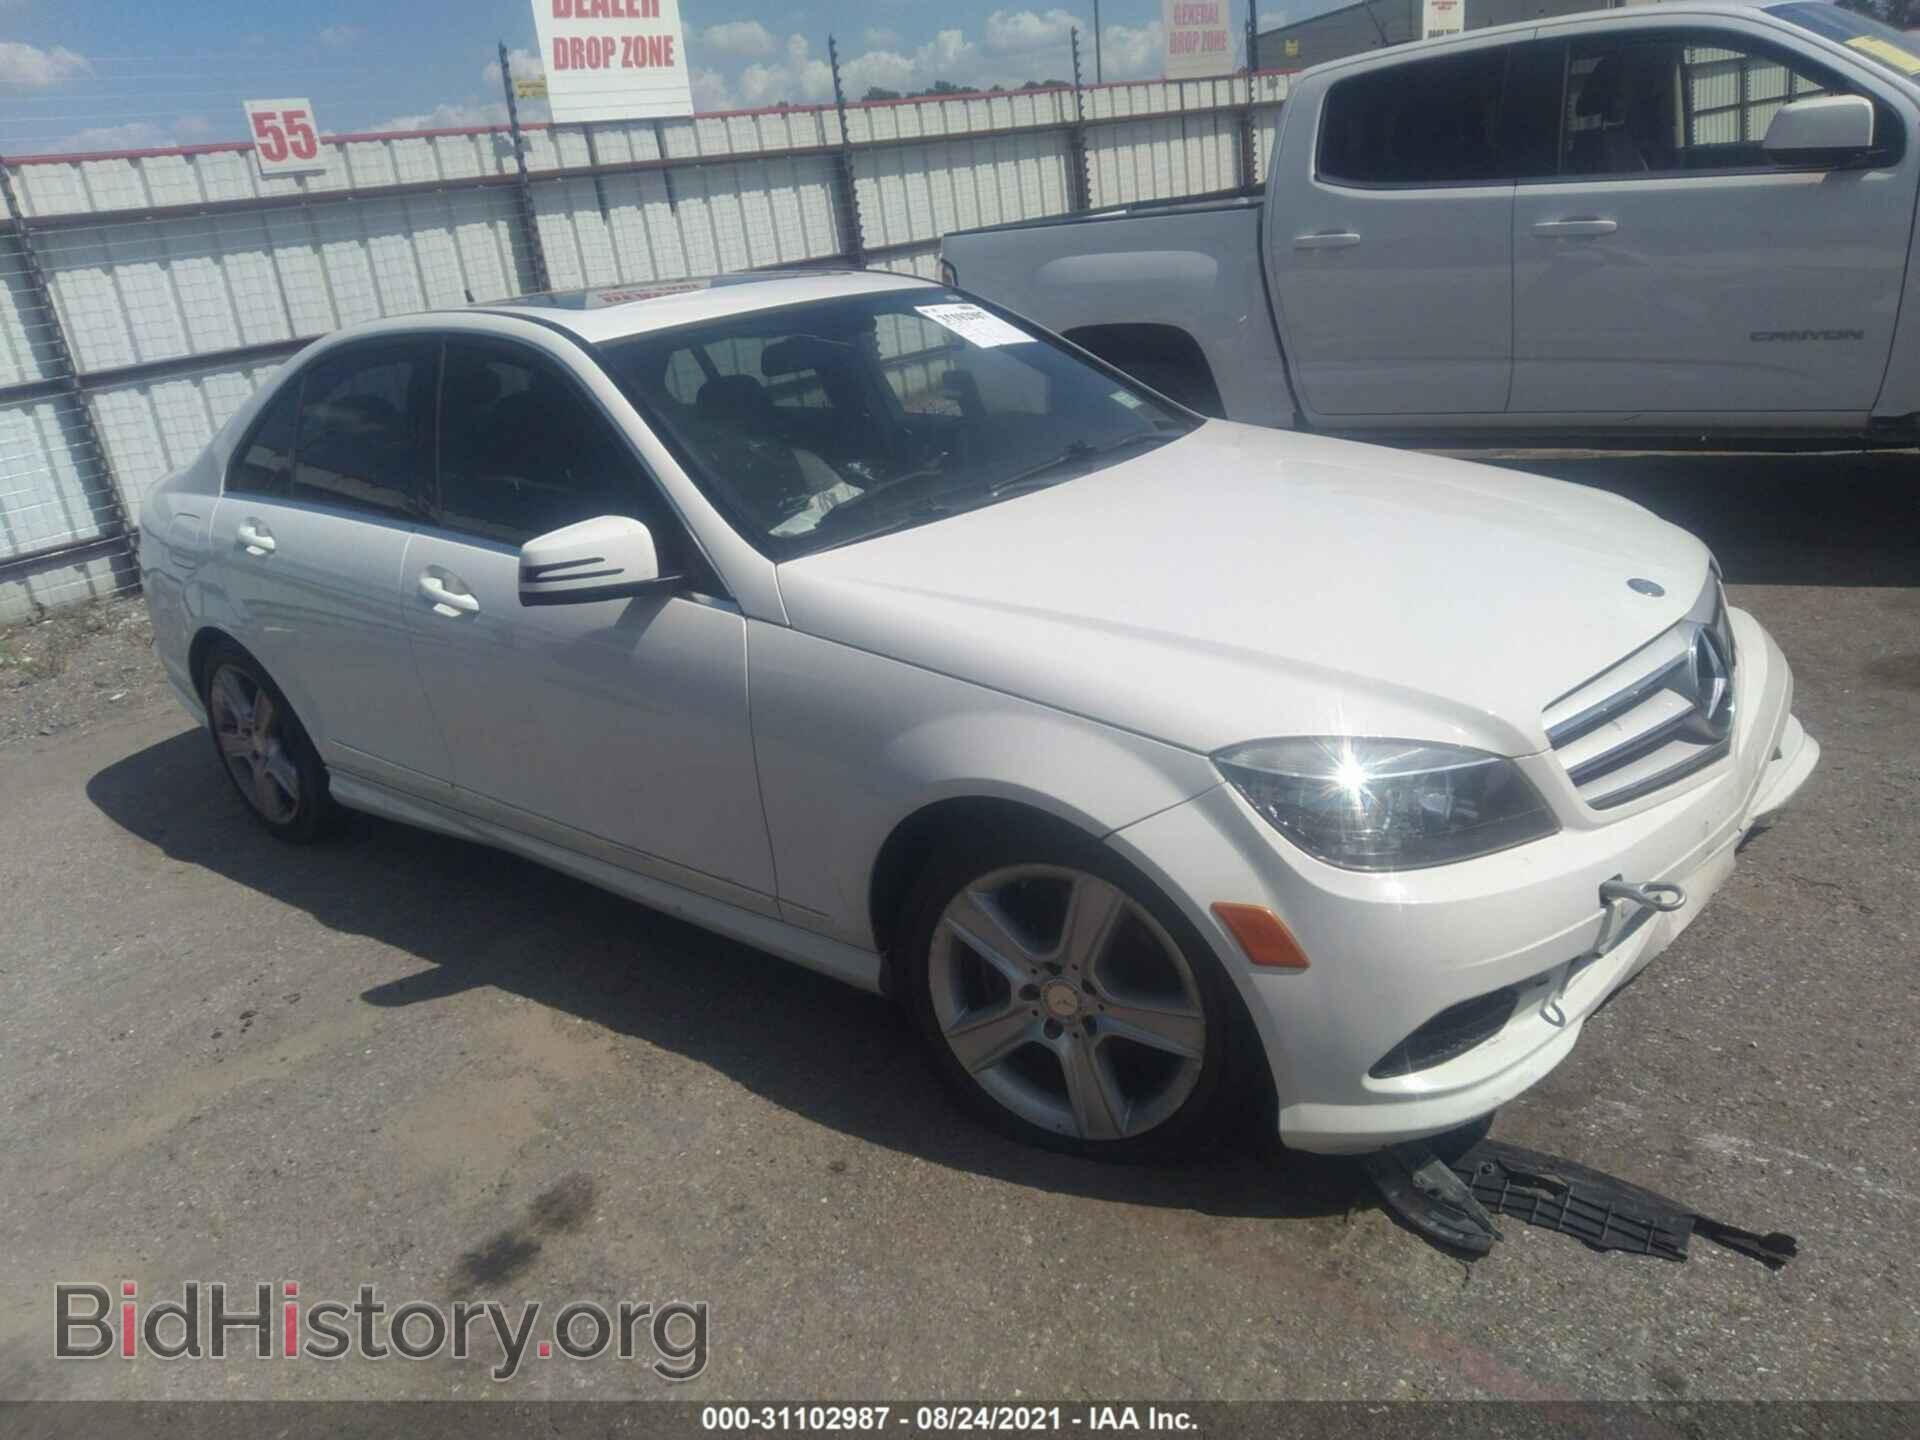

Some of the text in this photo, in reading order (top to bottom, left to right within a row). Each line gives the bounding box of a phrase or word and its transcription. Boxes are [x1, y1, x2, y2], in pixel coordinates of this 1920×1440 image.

[1174, 4, 1218, 25] GENERAL
[552, 35, 675, 71] DROP ZONE
[1168, 30, 1227, 54] DROP ZONE
[251, 110, 318, 161] 55
[1749, 329, 1865, 342] CANYON
